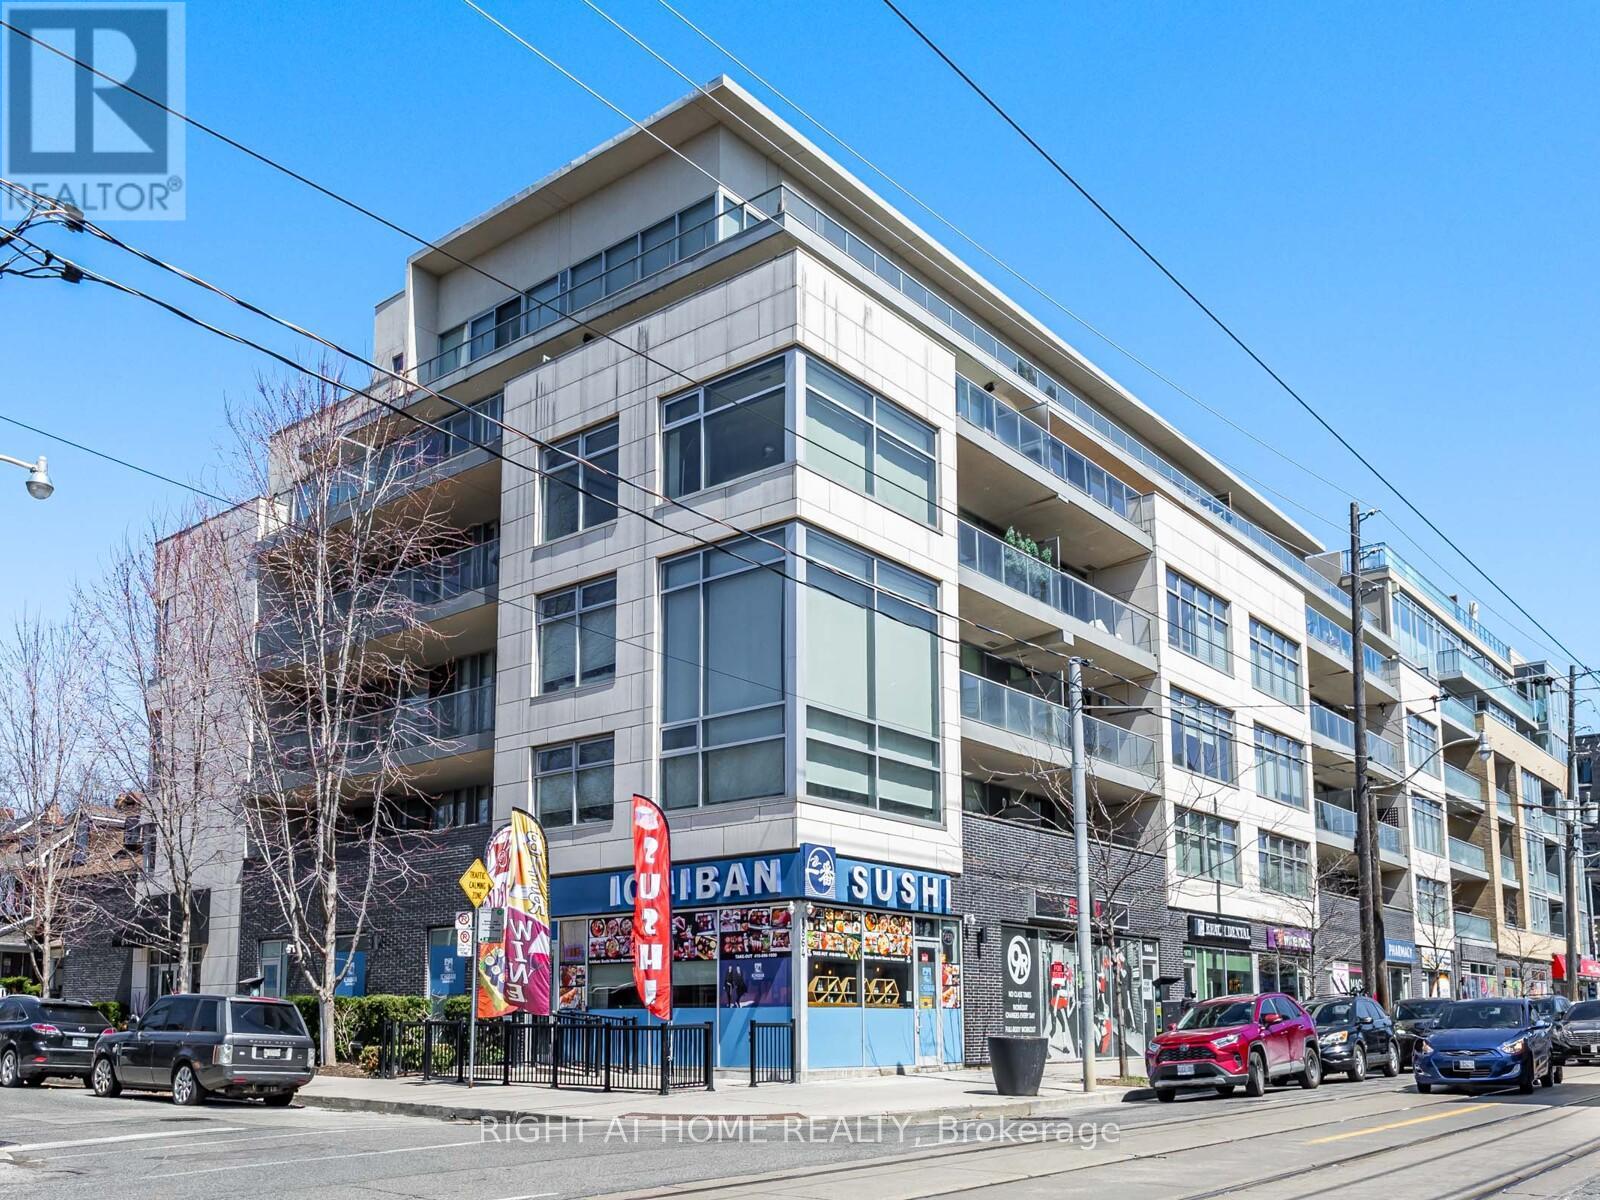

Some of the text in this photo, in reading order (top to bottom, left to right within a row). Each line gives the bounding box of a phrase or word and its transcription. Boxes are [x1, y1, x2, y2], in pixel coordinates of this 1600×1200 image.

[470, 872, 486, 880] TRAFFIC
[468, 882, 486, 890] CALMING
[609, 859, 782, 907] ICIBAN
[852, 866, 951, 909] SUSHI
[472, 892, 482, 900] ZONE
[1388, 943, 1413, 958] PHARMACY
